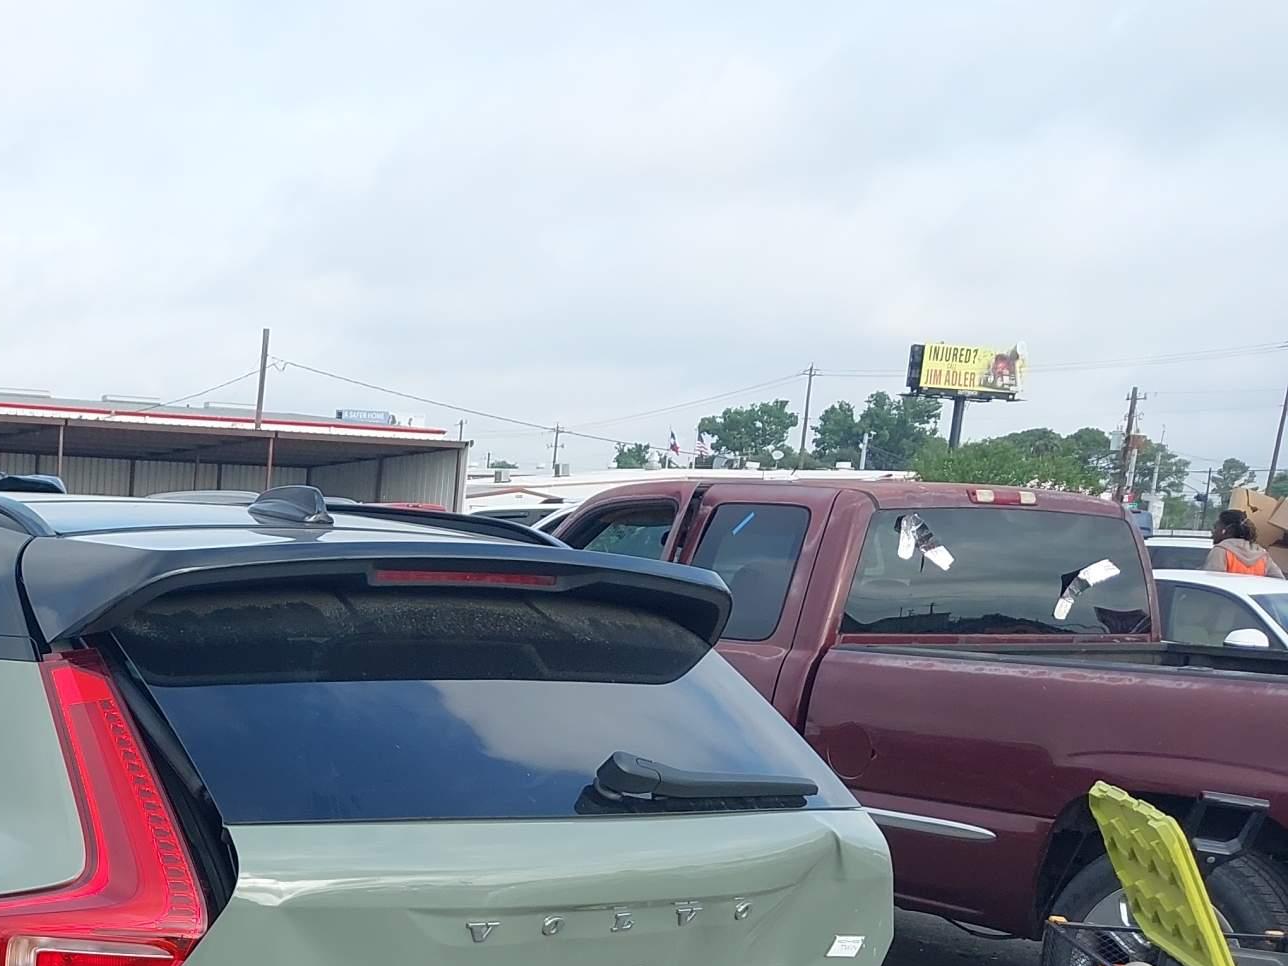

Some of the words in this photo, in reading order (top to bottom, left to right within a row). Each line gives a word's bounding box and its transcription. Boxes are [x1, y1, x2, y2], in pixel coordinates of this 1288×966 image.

[928, 344, 979, 365] INJURED?
[924, 368, 942, 385] JIM
[944, 369, 976, 388] ADLER
[465, 897, 753, 943] VOLVO
